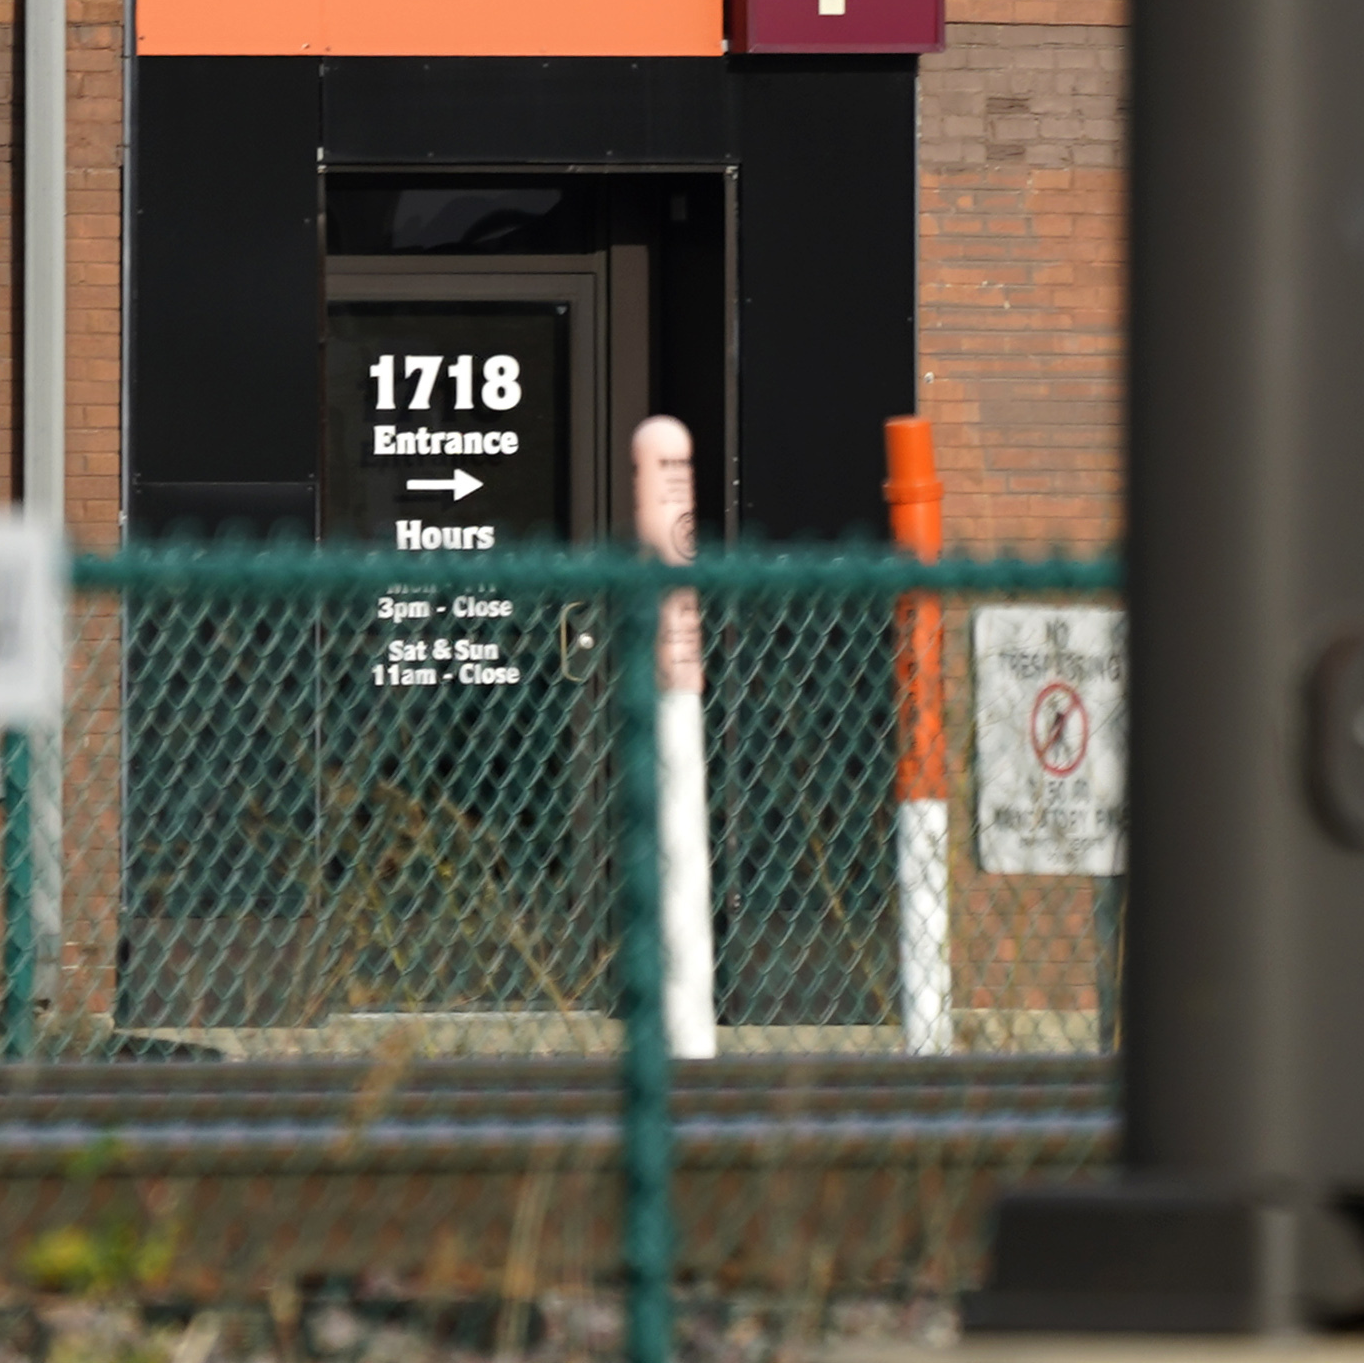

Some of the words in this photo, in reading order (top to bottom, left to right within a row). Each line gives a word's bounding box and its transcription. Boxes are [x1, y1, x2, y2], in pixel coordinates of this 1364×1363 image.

[370, 354, 522, 411] 1718
[373, 425, 519, 456] Entrance
[395, 520, 496, 550] Hours
[377, 596, 431, 624] 3pm
[452, 595, 514, 618] Close
[388, 639, 428, 662] Sat
[431, 638, 452, 661] &
[454, 639, 500, 661] Sun
[371, 663, 438, 686] 11am
[458, 663, 522, 685] Close
